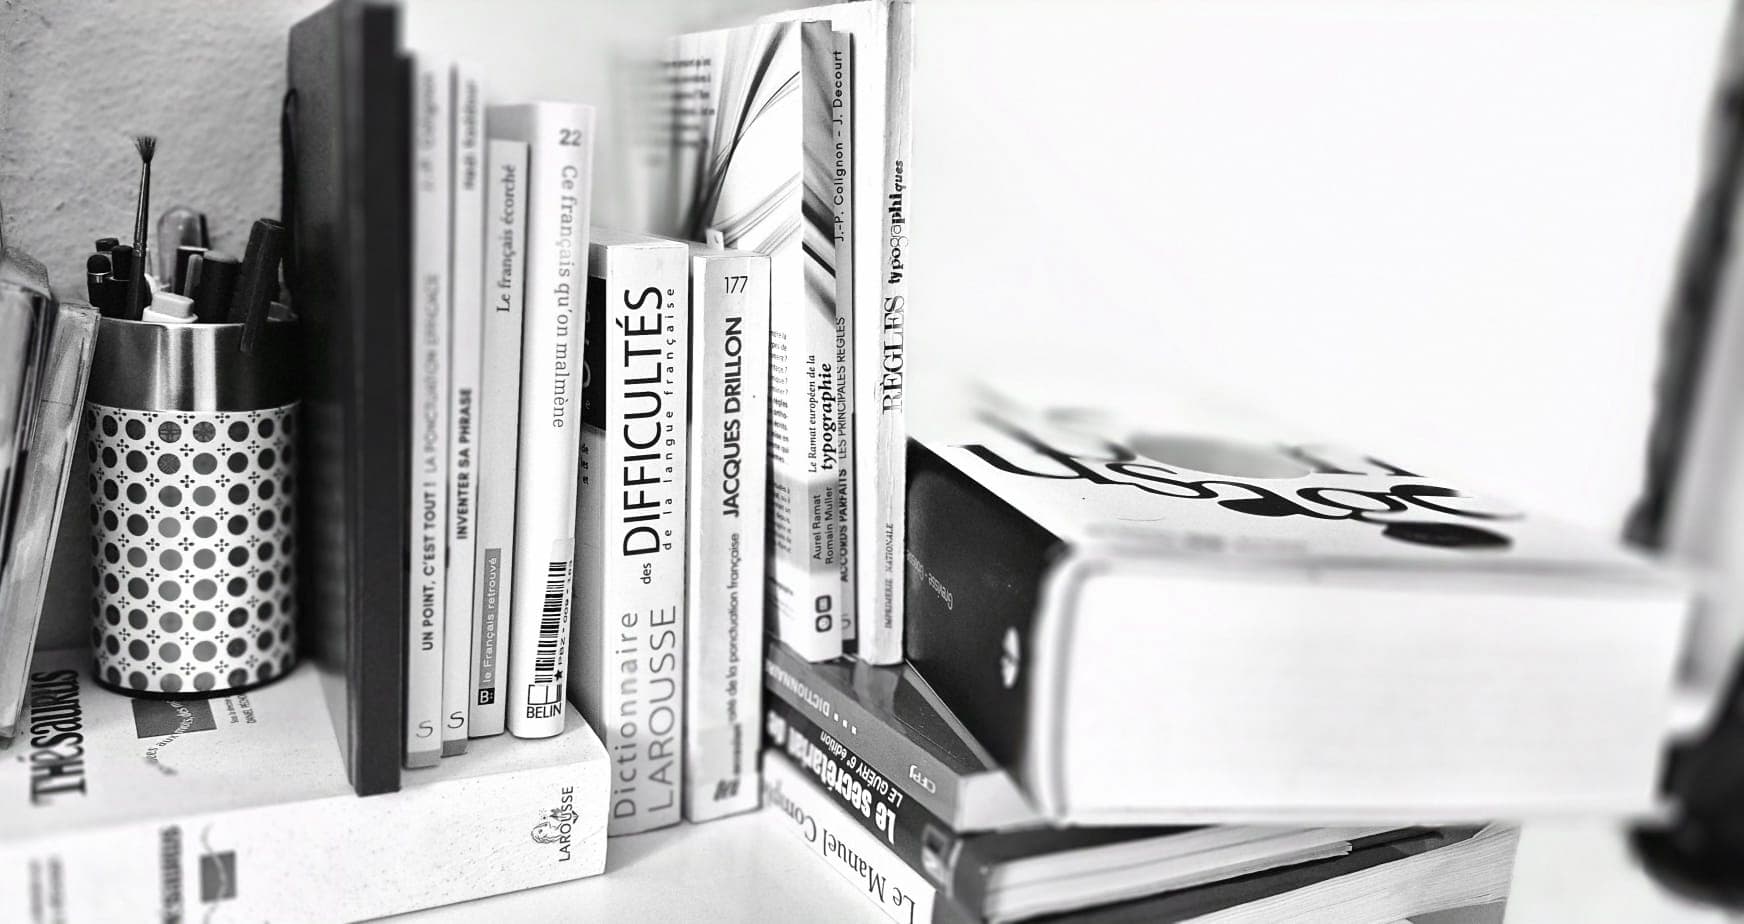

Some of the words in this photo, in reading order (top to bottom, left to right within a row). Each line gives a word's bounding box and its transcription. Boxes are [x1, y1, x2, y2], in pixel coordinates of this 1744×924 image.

[832, 50, 843, 108] Decourt
[559, 129, 582, 146] 22
[833, 113, 842, 126] J.
[561, 165, 578, 191] Ce
[833, 141, 846, 207] Colignon
[500, 165, 516, 225] écorché
[556, 195, 578, 278] français
[834, 208, 845, 242] J.-P.
[888, 159, 908, 285] typographiques
[500, 229, 516, 290] français
[496, 294, 511, 312] Le
[724, 276, 748, 294] 177
[664, 287, 677, 396] française
[806, 354, 815, 365] la
[880, 295, 905, 415] RÈGLES
[553, 342, 570, 428] malmène
[724, 317, 742, 413] DRILLON
[806, 366, 816, 379] de
[458, 387, 472, 444] PHRASE
[615, 286, 663, 557] DIFFICULTÉS
[806, 381, 819, 425] européen
[817, 363, 837, 471] typographie
[836, 365, 847, 437] PRINCIPALES
[458, 448, 471, 468] SA
[662, 410, 676, 484] langue
[808, 427, 817, 459] Ramat
[838, 439, 848, 460] LES
[424, 455, 438, 474] LA
[723, 419, 741, 518] JACQUES
[808, 461, 817, 473] Le
[423, 491, 437, 531] TOUT
[457, 472, 471, 540] INVENTER
[662, 497, 673, 515] la
[812, 494, 822, 531] Ramat
[824, 486, 833, 522] Muller
[838, 468, 849, 522] PARFAITS
[423, 535, 437, 577] C'EST
[663, 529, 673, 551] de
[812, 532, 822, 560] Aurel
[824, 524, 834, 564] Romain
[839, 525, 849, 583] ACCORDS
[639, 563, 652, 585] des
[727, 532, 742, 592] française
[488, 557, 498, 609] retrouvé
[423, 580, 437, 628] POINT,
[422, 632, 435, 652] UN
[483, 614, 496, 668] Français
[727, 591, 741, 664] ponctuation
[482, 671, 492, 683] le
[726, 663, 738, 677] la
[727, 677, 738, 696] de
[526, 702, 563, 719] BELIN
[613, 611, 639, 819] Dictionnaire
[647, 605, 676, 813] LAROUSSE
[819, 731, 848, 762] édition
[856, 759, 889, 796] GUÉRY
[886, 785, 904, 808] LE
[909, 764, 937, 794] CFPJ
[558, 786, 574, 862] LAROUSSE
[875, 799, 897, 846] Le
[821, 827, 887, 904] Manuel
[892, 885, 916, 924] Le
